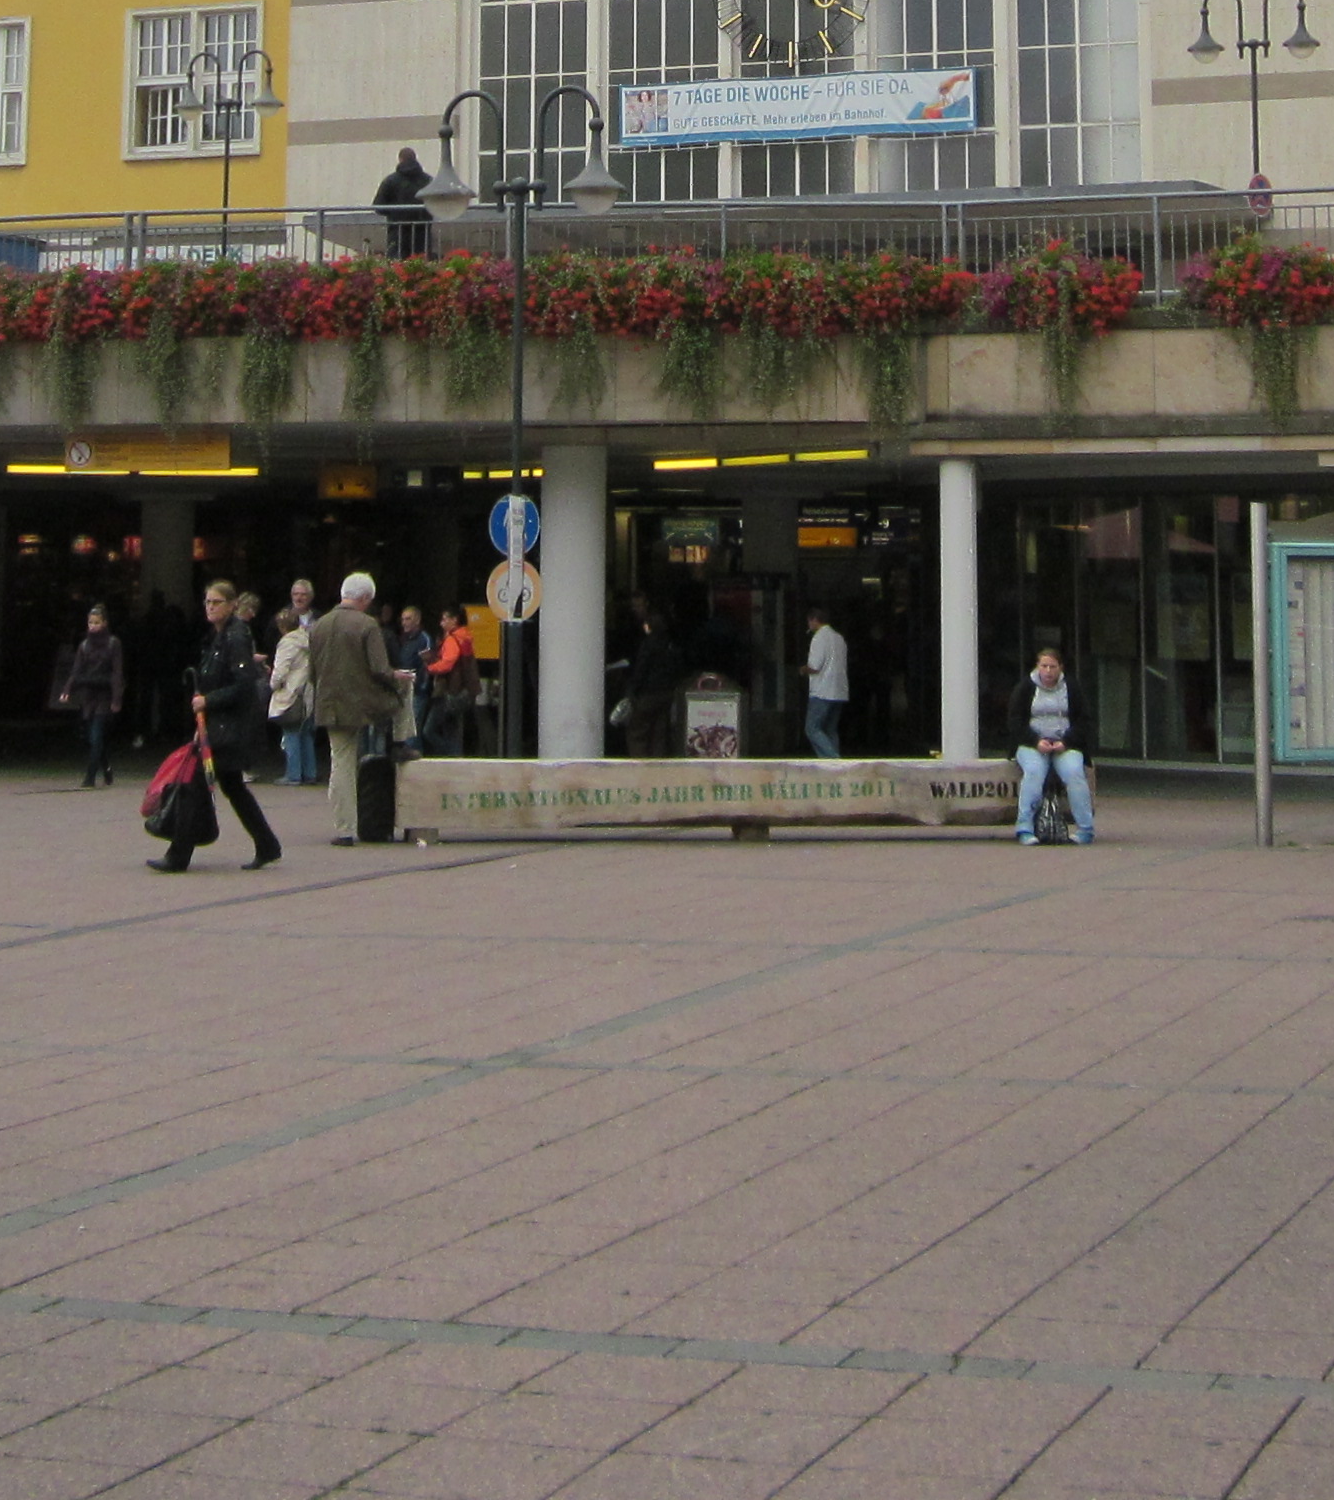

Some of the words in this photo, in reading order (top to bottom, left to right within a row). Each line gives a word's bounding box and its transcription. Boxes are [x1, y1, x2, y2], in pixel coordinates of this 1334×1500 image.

[672, 90, 681, 106] 7
[685, 87, 723, 105] TAGE
[726, 85, 751, 103] DIE
[754, 82, 810, 102] WOCHE
[826, 79, 857, 98] FÜR
[860, 79, 885, 97] SIE
[888, 77, 915, 95] DA.
[673, 116, 699, 129] GUTE
[763, 113, 788, 126] Mehr
[791, 111, 827, 124] erleben
[829, 110, 842, 122] im
[844, 107, 888, 121] Bahnhof.
[646, 784, 706, 804] JAHR
[711, 782, 753, 802] DER
[850, 779, 897, 798] 2011
